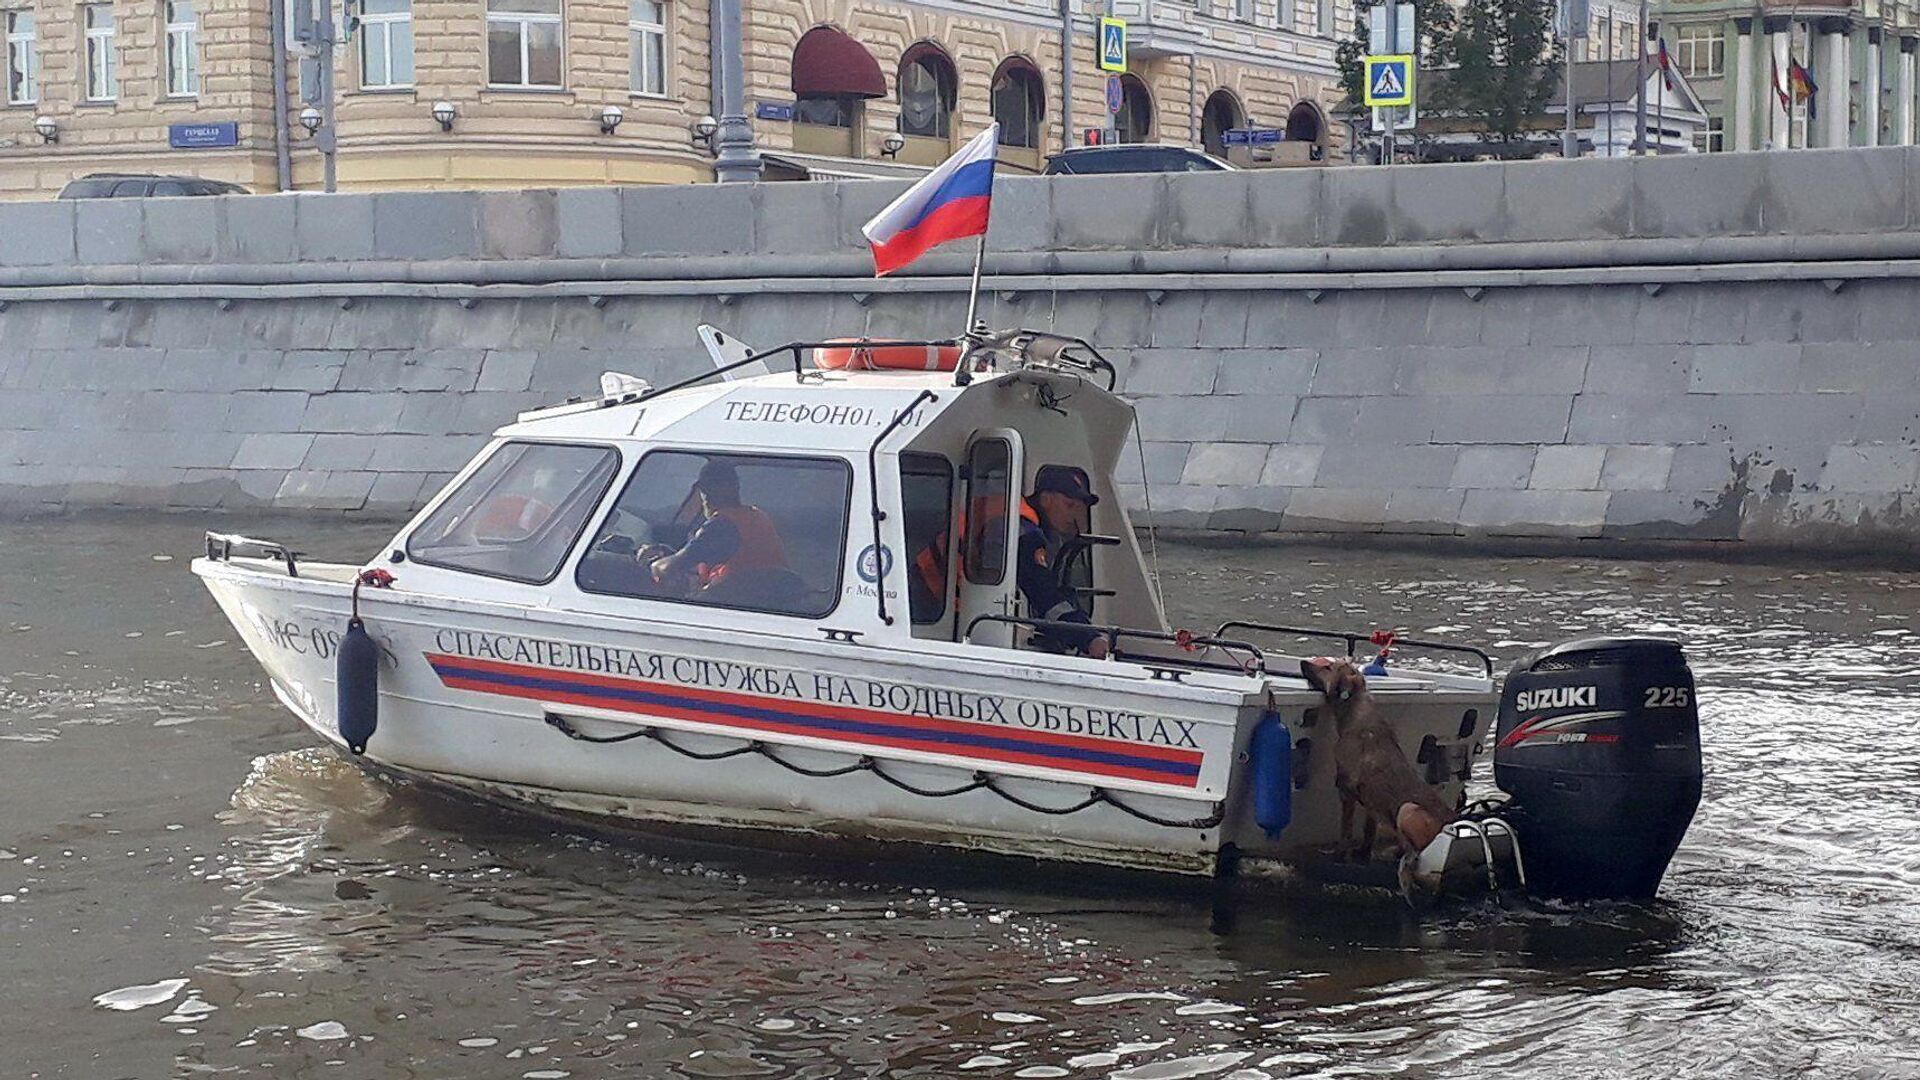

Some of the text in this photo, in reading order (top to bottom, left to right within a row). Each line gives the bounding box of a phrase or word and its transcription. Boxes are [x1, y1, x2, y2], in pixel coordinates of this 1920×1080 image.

[856, 585, 897, 600] Мосва
[435, 628, 664, 679] СПАСАТЕЛЬНАЯ
[672, 656, 802, 698] СЛУЖБА
[813, 674, 857, 704] НА
[867, 681, 1009, 725] ВОДНЫХ
[1016, 699, 1201, 749] ОБЪЕКТАХ
[1516, 686, 1689, 712] SUZUKI 225
